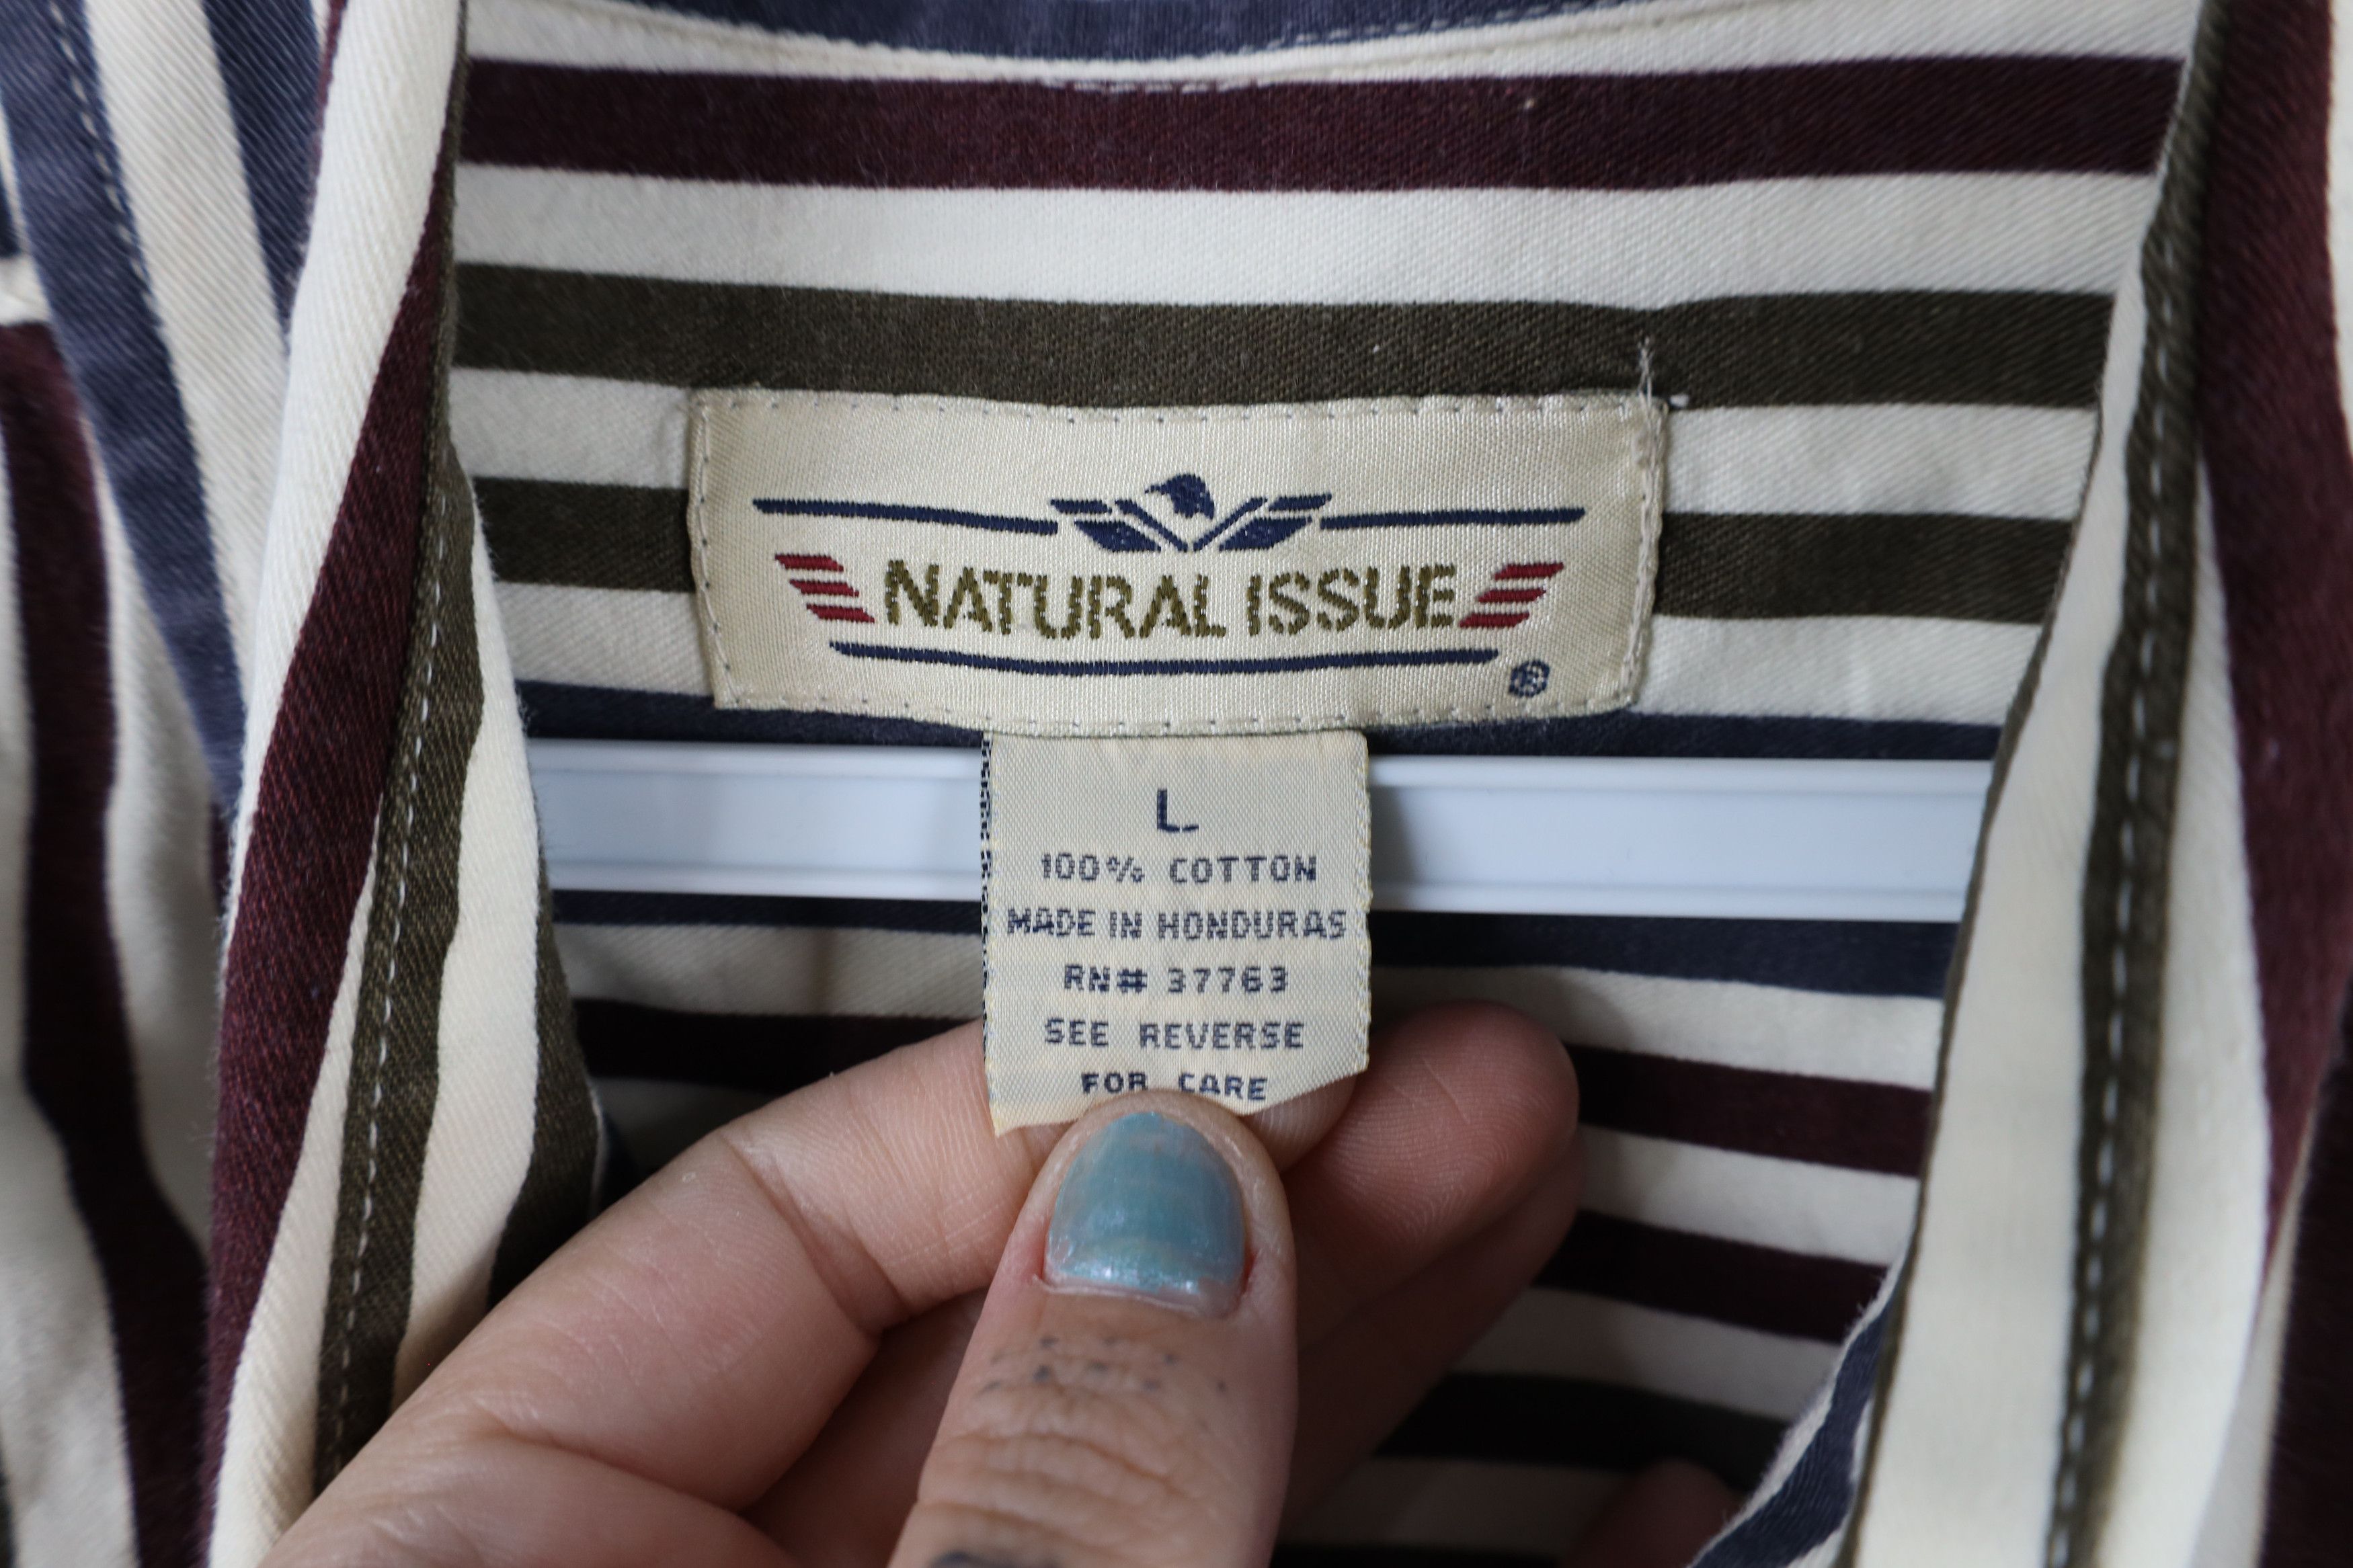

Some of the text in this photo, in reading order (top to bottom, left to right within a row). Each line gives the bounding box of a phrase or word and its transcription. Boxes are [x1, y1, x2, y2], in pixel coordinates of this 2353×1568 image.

[887, 559, 1456, 640] NATURAL ISSUE
[1156, 789, 1199, 833] L
[1041, 852, 1318, 883] 100% COTTON
[1007, 908, 1347, 941] MADE IN HONDURAS
[1064, 964, 1289, 993] RN# 37763
[1043, 1018, 1305, 1050] SEE REVERSE
[1081, 1072, 1269, 1102] FOR CARE
